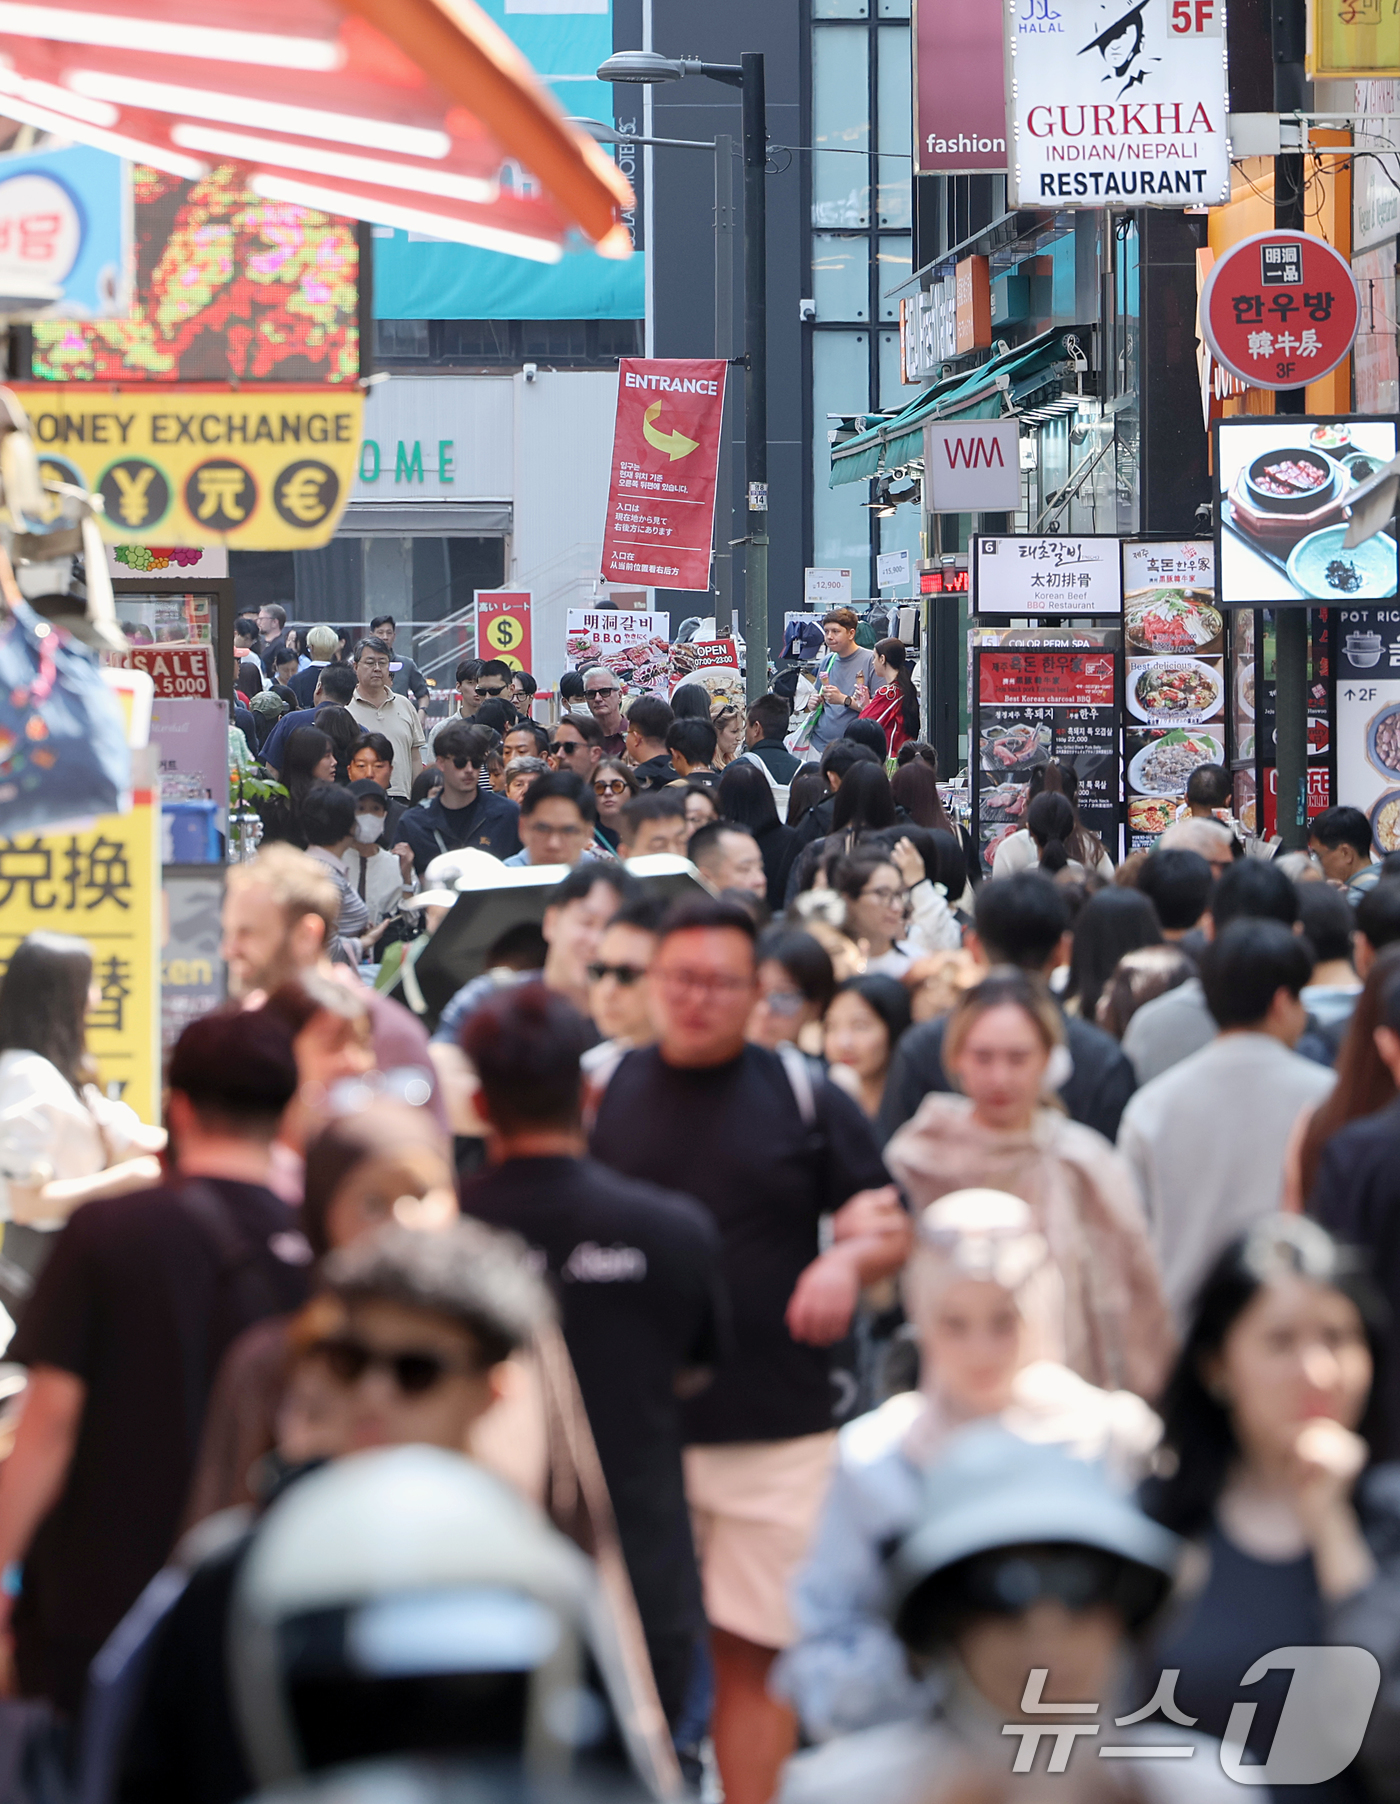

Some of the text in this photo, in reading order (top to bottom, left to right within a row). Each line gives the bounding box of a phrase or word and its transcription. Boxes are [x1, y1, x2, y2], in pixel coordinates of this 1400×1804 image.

[1171, 0, 1214, 33] 5F
[1019, 22, 1065, 33] HALAL
[1027, 101, 1217, 138] GURKHA
[926, 133, 1006, 153] fashion
[1046, 142, 1198, 162] INDIAN/NEPALI
[1040, 169, 1207, 197] RESTAURANT
[1265, 247, 1297, 264] 明洞
[1266, 265, 1299, 282] 一品
[1231, 292, 1335, 325] 한우방
[1247, 328, 1323, 361] 韓牛房
[1276, 362, 1296, 379] 3F
[625, 372, 719, 396] ENTRANCE
[151, 413, 354, 443] EXCHANGE
[943, 436, 1005, 469] WM
[620, 461, 640, 472] 입구는
[619, 470, 663, 483] 현재 위치 기준
[618, 479, 639, 488] 오른쪽
[754, 495, 765, 504] 14
[616, 502, 640, 512] 入口は
[614, 512, 668, 526] 現在地から見て
[613, 522, 673, 536] 右後方にあります
[985, 541, 994, 552] 6
[611, 551, 635, 561] 入口在
[1018, 540, 1084, 567] 태초갈비
[1132, 548, 1149, 559] 제주
[610, 561, 680, 576] 从当前位置看右后方
[1030, 572, 1092, 588] 太初排骨
[1034, 592, 1088, 600] Korean Beef
[478, 601, 530, 613] 高い レート
[1027, 601, 1095, 610] BBQ Restaurant
[1340, 610, 1369, 623] POT
[1377, 610, 1400, 623] RIC
[583, 614, 653, 633] 明洞갈비
[497, 618, 513, 648] $
[593, 633, 622, 643] B.B.Q
[1008, 639, 1090, 648] COLOR PERM SPA
[696, 644, 728, 657] OPEN
[133, 655, 206, 676] SALE
[694, 655, 734, 667] 07:00~23:00
[1130, 661, 1192, 671] Best delicious
[1004, 695, 1091, 703] Best Korean charcoal BBQ
[1358, 688, 1377, 701] 2F
[1307, 728, 1327, 737] ntry
